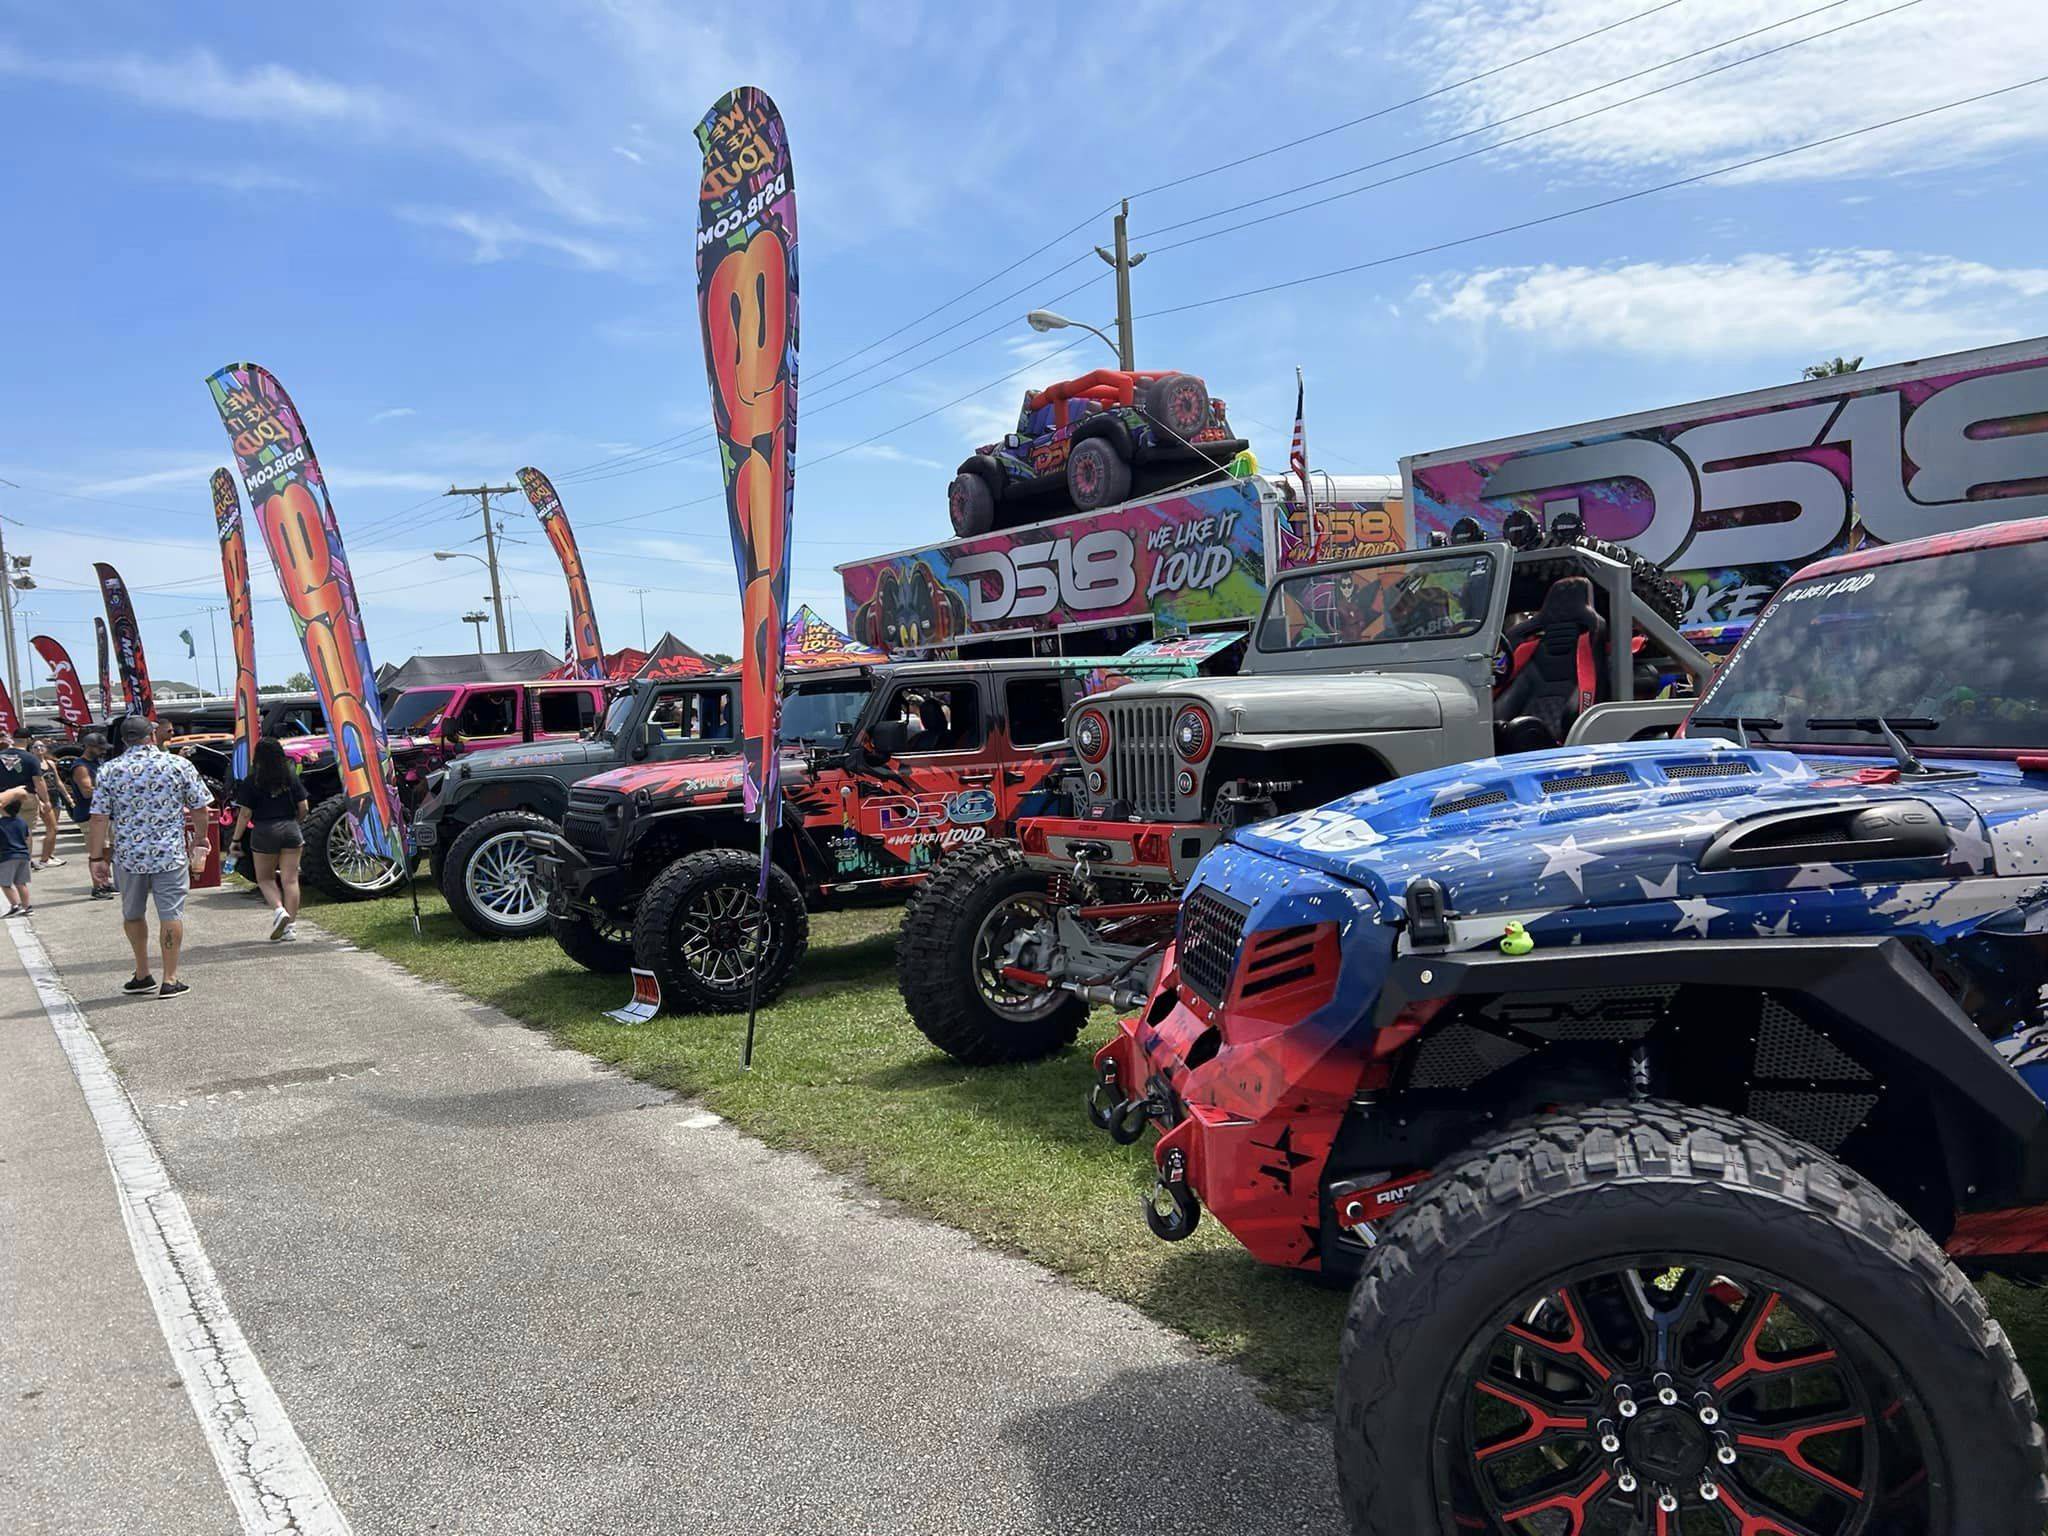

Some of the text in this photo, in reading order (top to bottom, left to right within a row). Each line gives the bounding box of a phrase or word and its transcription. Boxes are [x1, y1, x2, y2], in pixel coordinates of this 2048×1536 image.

[1147, 511, 1241, 551] WE LIKE IT
[950, 529, 1137, 622] DS18
[1147, 543, 1235, 601] LOUD
[1826, 573, 1876, 601] LOUD
[801, 639, 844, 653] LOUD
[861, 789, 997, 831] DS18
[827, 836, 857, 849] Jeep
